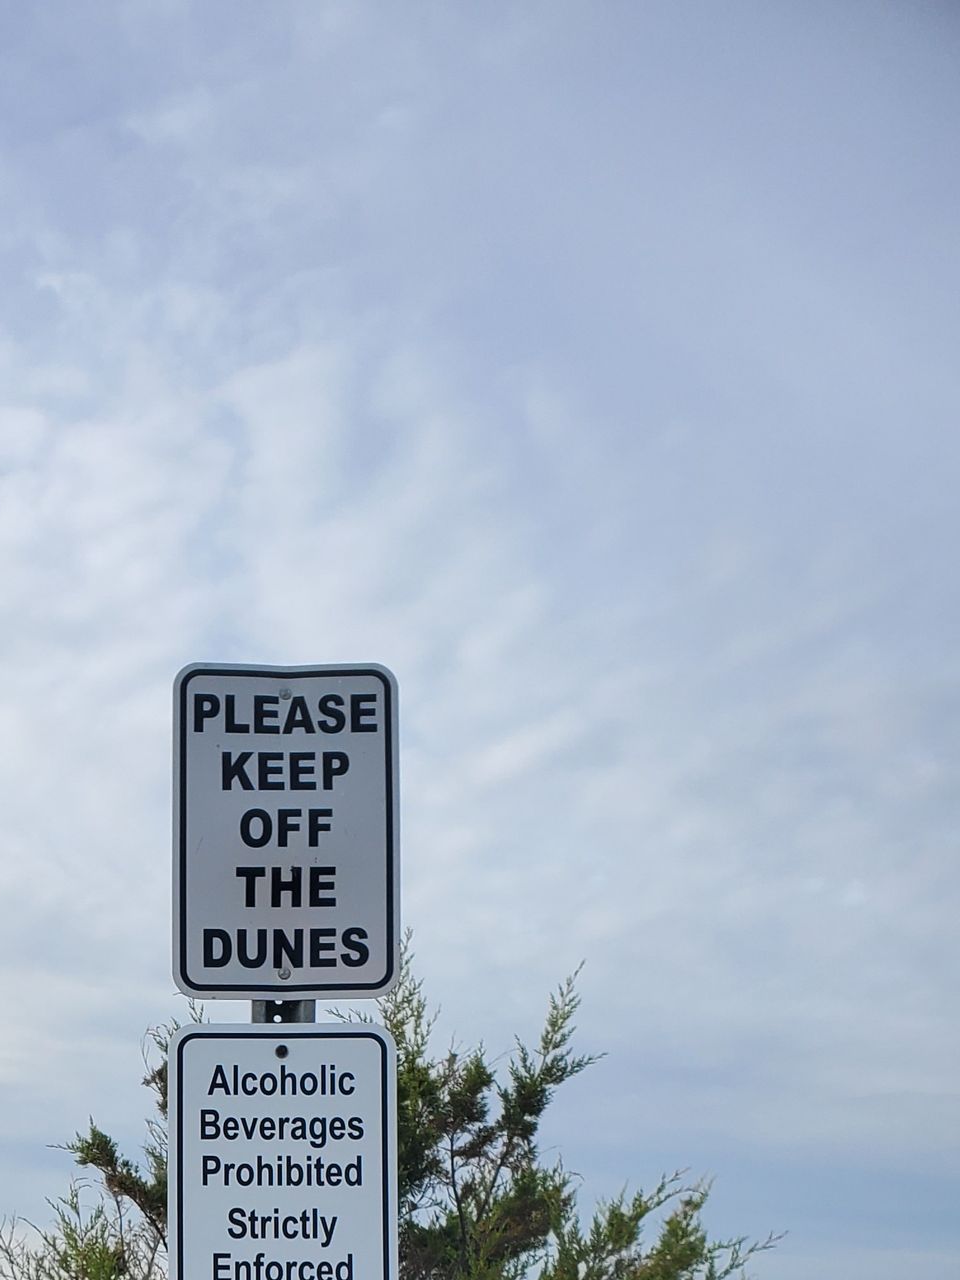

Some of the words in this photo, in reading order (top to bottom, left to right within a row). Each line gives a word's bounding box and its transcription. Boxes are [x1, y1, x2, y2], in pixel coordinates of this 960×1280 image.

[193, 693, 379, 734] PLEASE
[221, 751, 350, 791] KEEP
[240, 808, 333, 848] OFF
[236, 866, 337, 907] THE
[203, 927, 370, 969] DUNES
[207, 1064, 356, 1096] Alcoholic
[200, 1109, 364, 1148] Beverages
[202, 1155, 363, 1186] Prohibited
[227, 1207, 338, 1247] Strictly
